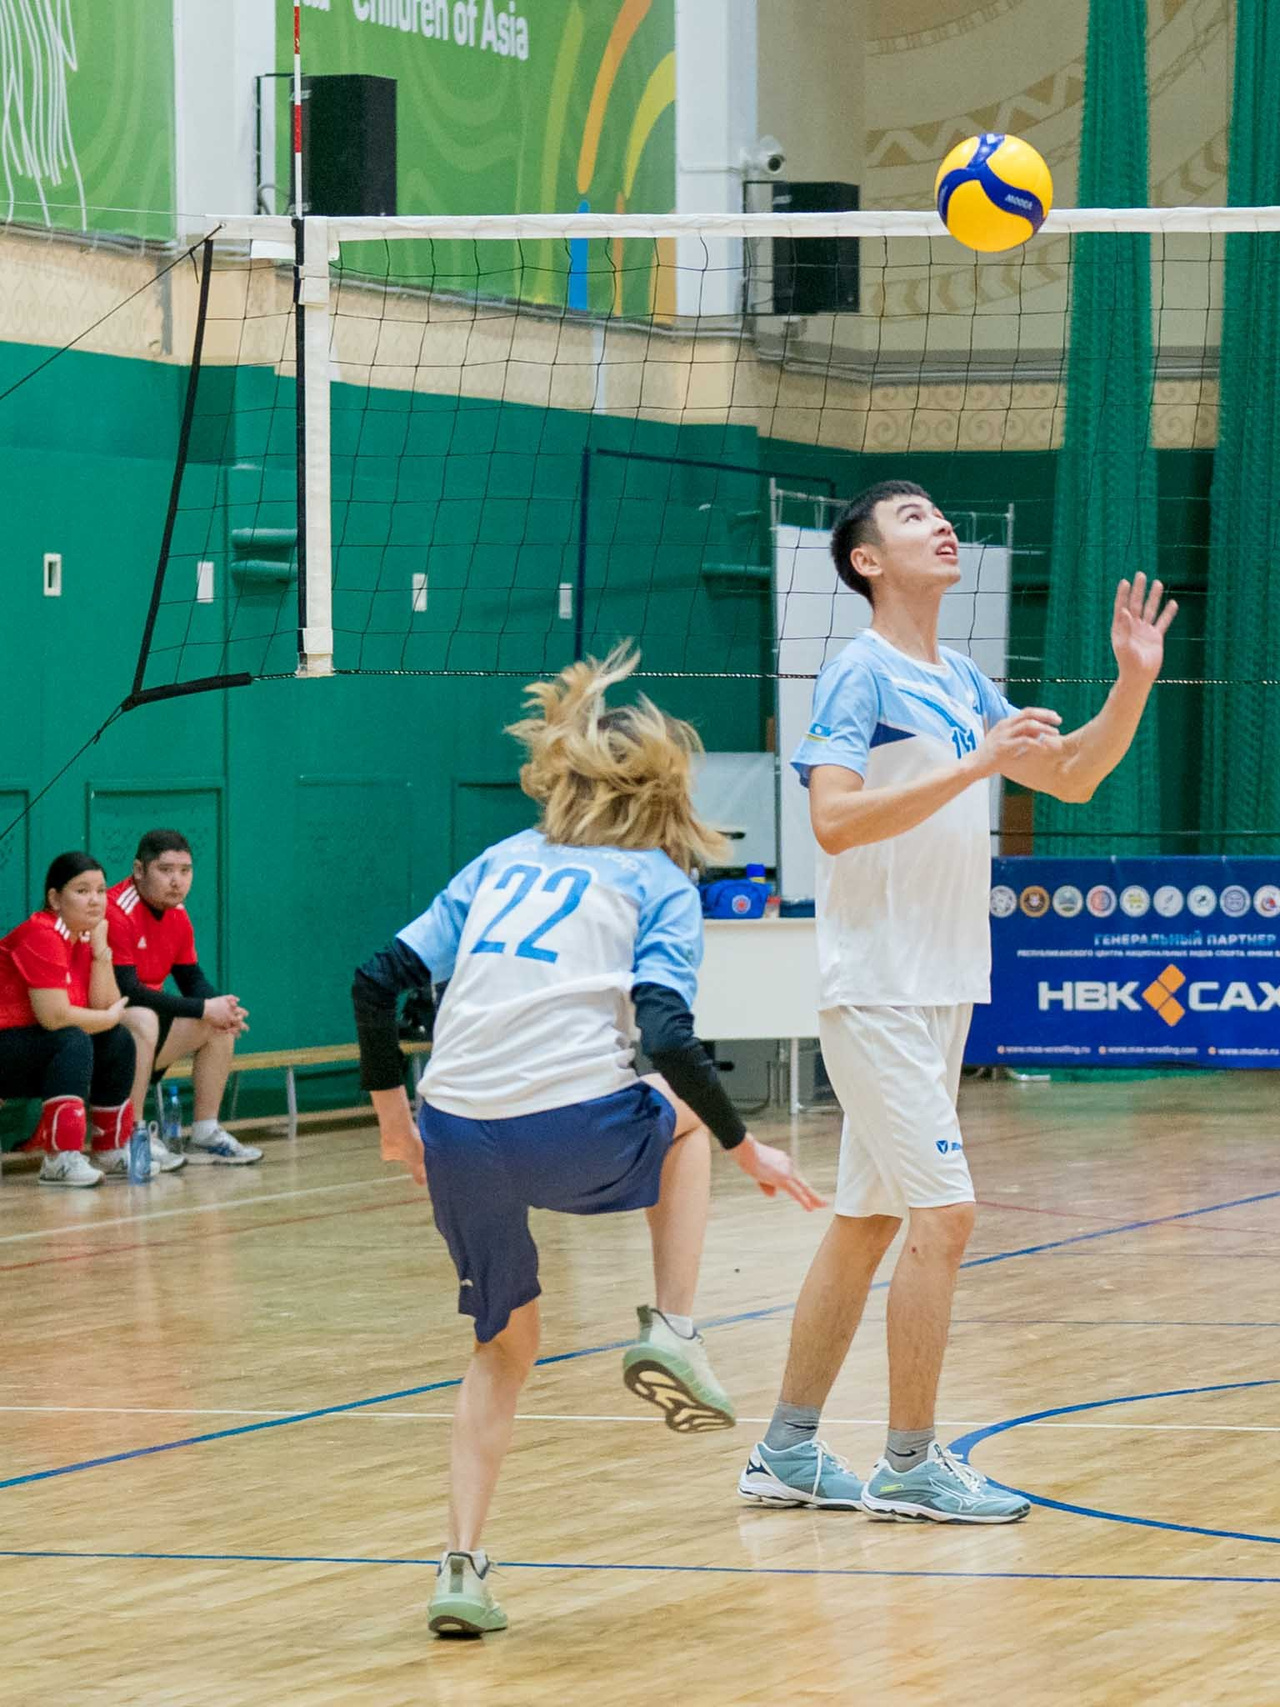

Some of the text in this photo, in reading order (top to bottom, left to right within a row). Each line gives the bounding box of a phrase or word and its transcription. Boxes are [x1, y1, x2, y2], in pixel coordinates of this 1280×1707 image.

[454, 1, 477, 47] of
[480, 0, 529, 60] Asia
[471, 863, 592, 964] 22
[1093, 930, 1276, 946] ГЕНЕРАЛЬНЫЙ ПАРТНЕР
[1038, 981, 1142, 1011] НВК
